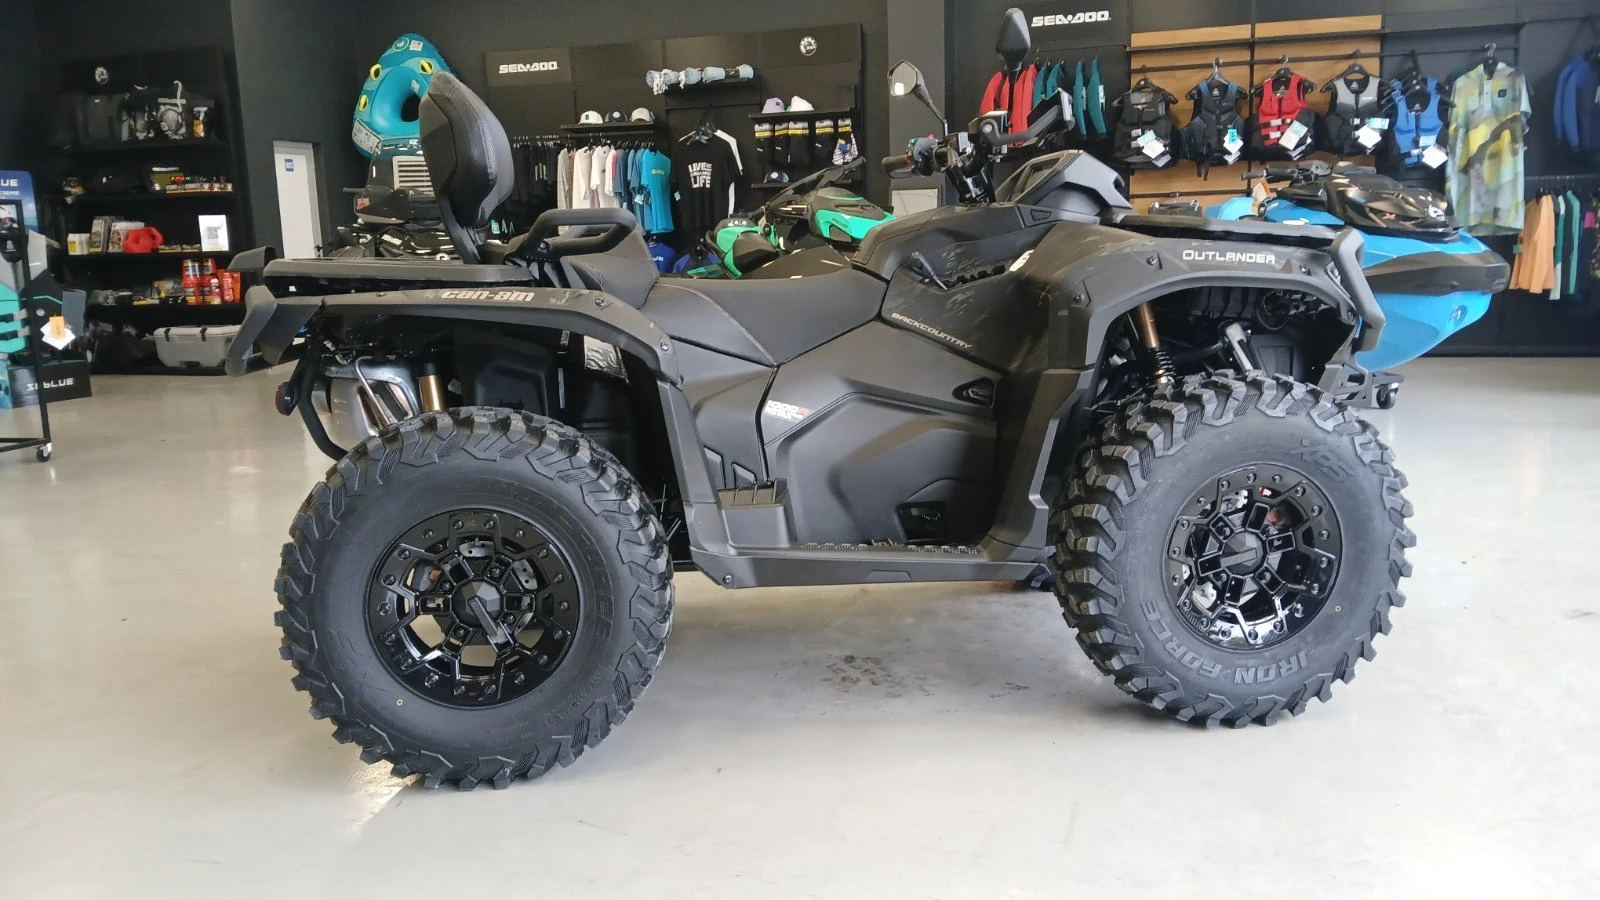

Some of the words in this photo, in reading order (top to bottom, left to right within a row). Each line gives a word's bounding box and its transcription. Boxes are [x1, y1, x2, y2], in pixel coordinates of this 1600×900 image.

[1182, 249, 1275, 264] OUTLANDER
[890, 312, 973, 349] BACKCOUNTRY
[1140, 600, 1223, 680] FORCE
[1233, 651, 1309, 684] IRON
